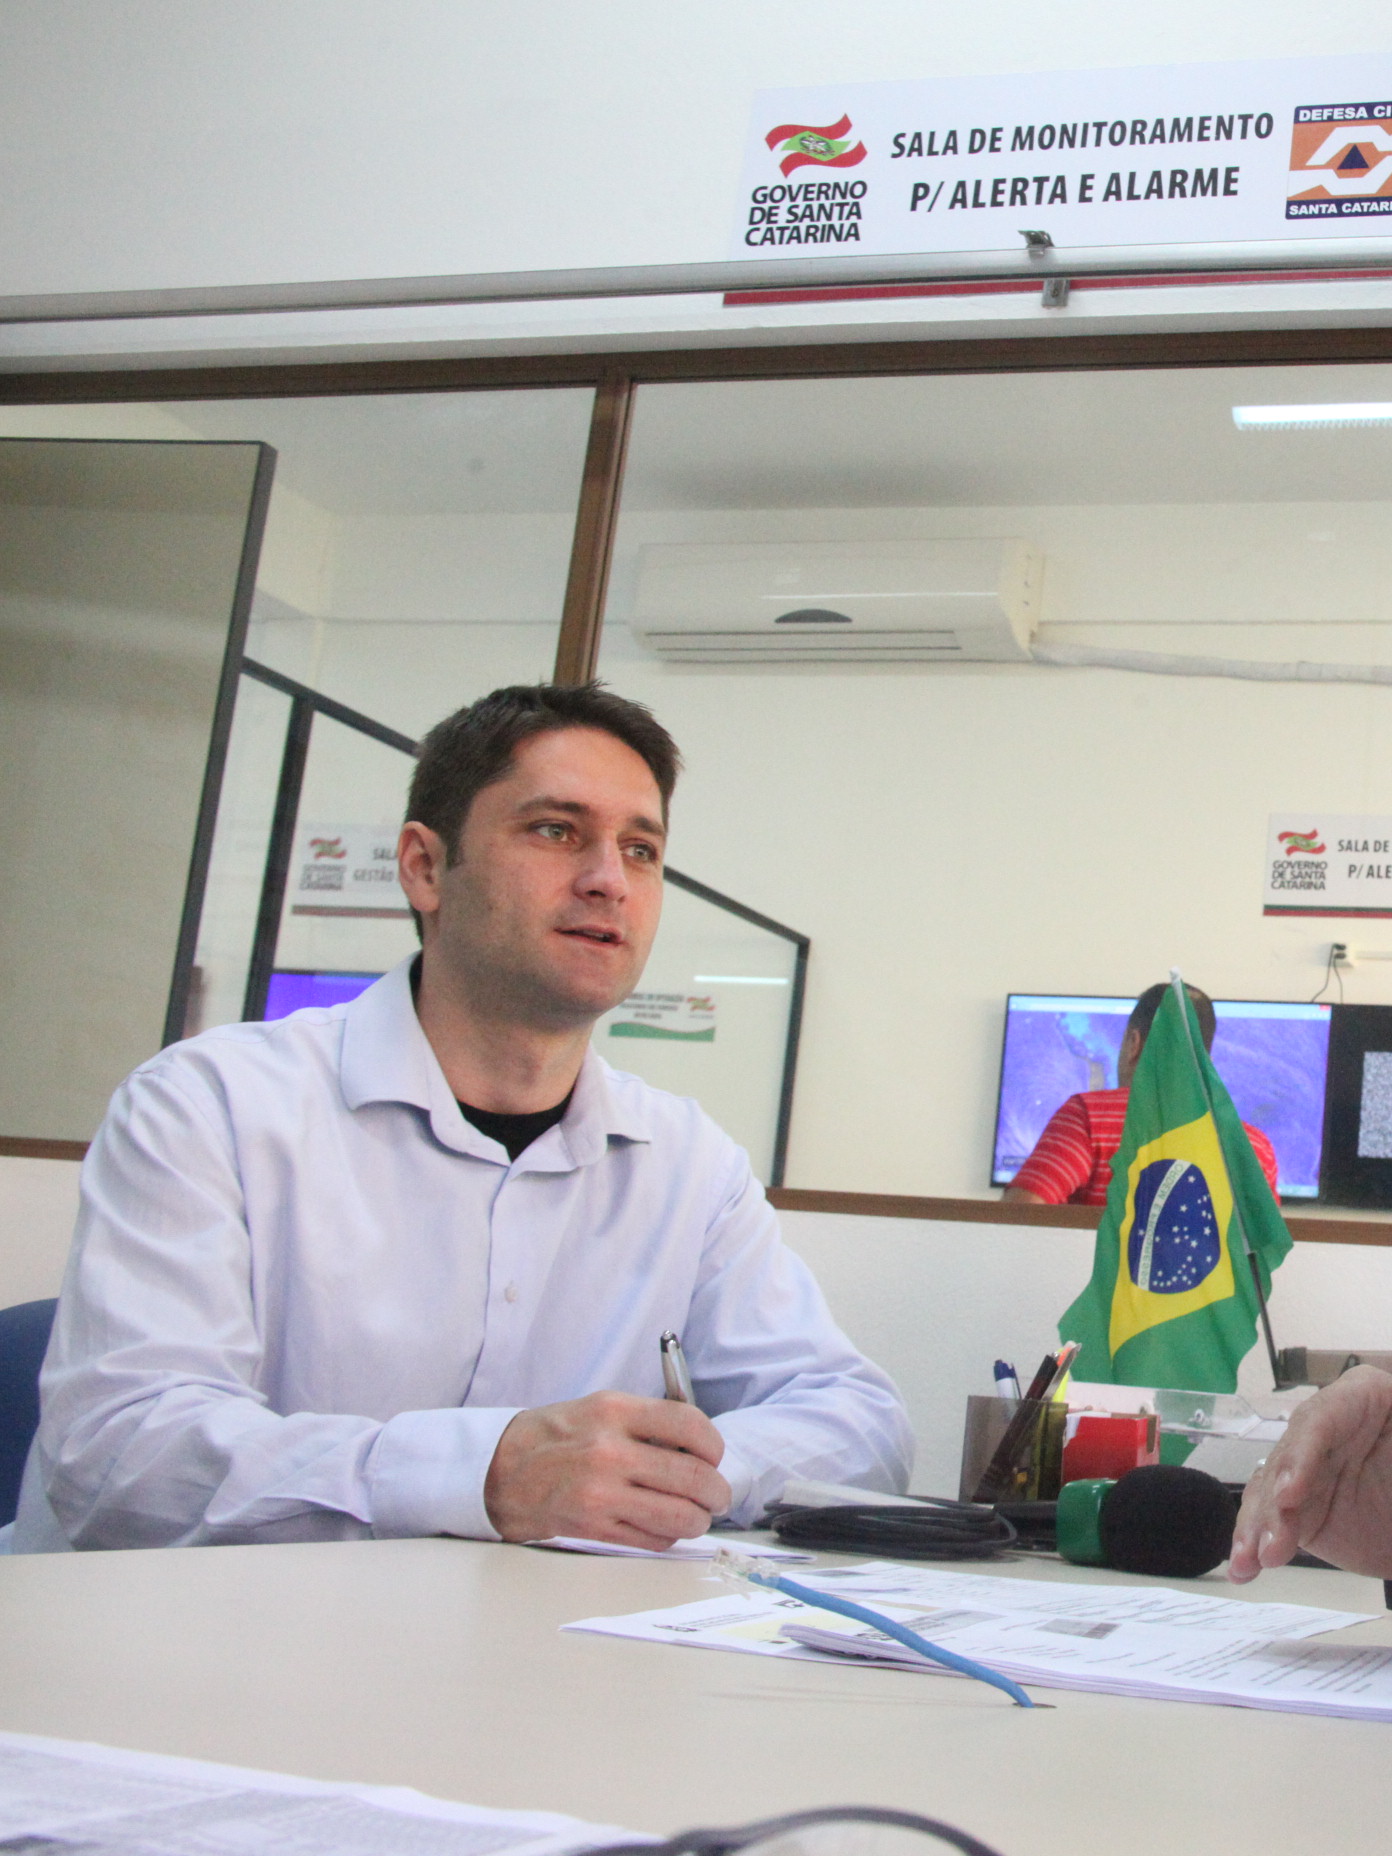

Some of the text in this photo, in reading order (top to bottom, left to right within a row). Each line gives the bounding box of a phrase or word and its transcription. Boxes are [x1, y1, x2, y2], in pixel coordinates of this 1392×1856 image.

[1298, 106, 1369, 122] DEFESA
[891, 112, 1274, 159] SALA DE MONITORAMENTO
[751, 180, 868, 205] GOVERNO
[909, 166, 1241, 213] P/ ALERTA E ALARME
[748, 201, 862, 226] DE SANTA
[1289, 203, 1338, 216] SANTA
[744, 222, 861, 247] CATARINA
[1338, 840, 1369, 852] SALA
[1373, 840, 1389, 853] DE
[1272, 860, 1328, 870] GOVERNO
[1348, 864, 1363, 879] P/
[1272, 870, 1326, 880] DE SANTA
[1271, 880, 1326, 890] CATARINA
